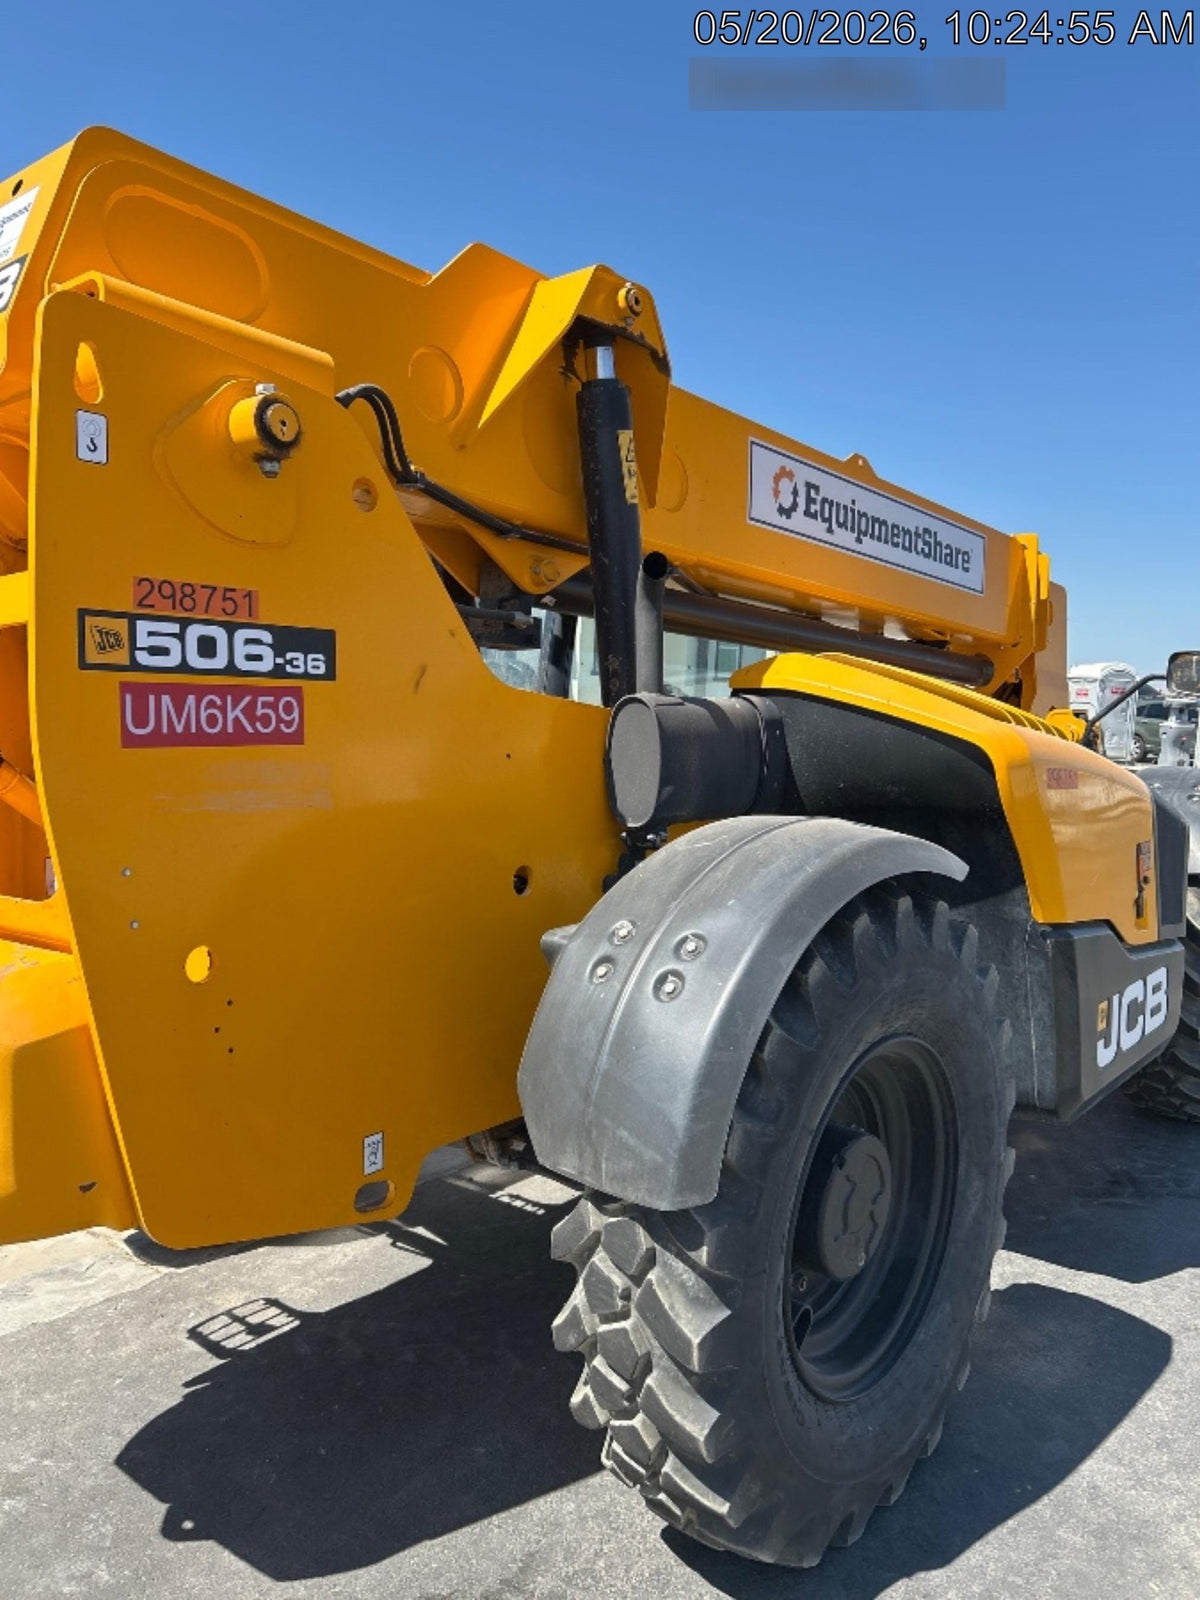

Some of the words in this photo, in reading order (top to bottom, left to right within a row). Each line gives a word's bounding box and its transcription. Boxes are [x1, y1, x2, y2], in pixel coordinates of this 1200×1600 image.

[803, 480, 971, 573] EquipmentShare
[136, 577, 254, 618] 298751
[94, 625, 125, 654] JCB
[134, 619, 326, 675] 506-36
[124, 693, 300, 736] UM6K59
[1096, 966, 1168, 1068] JCB
